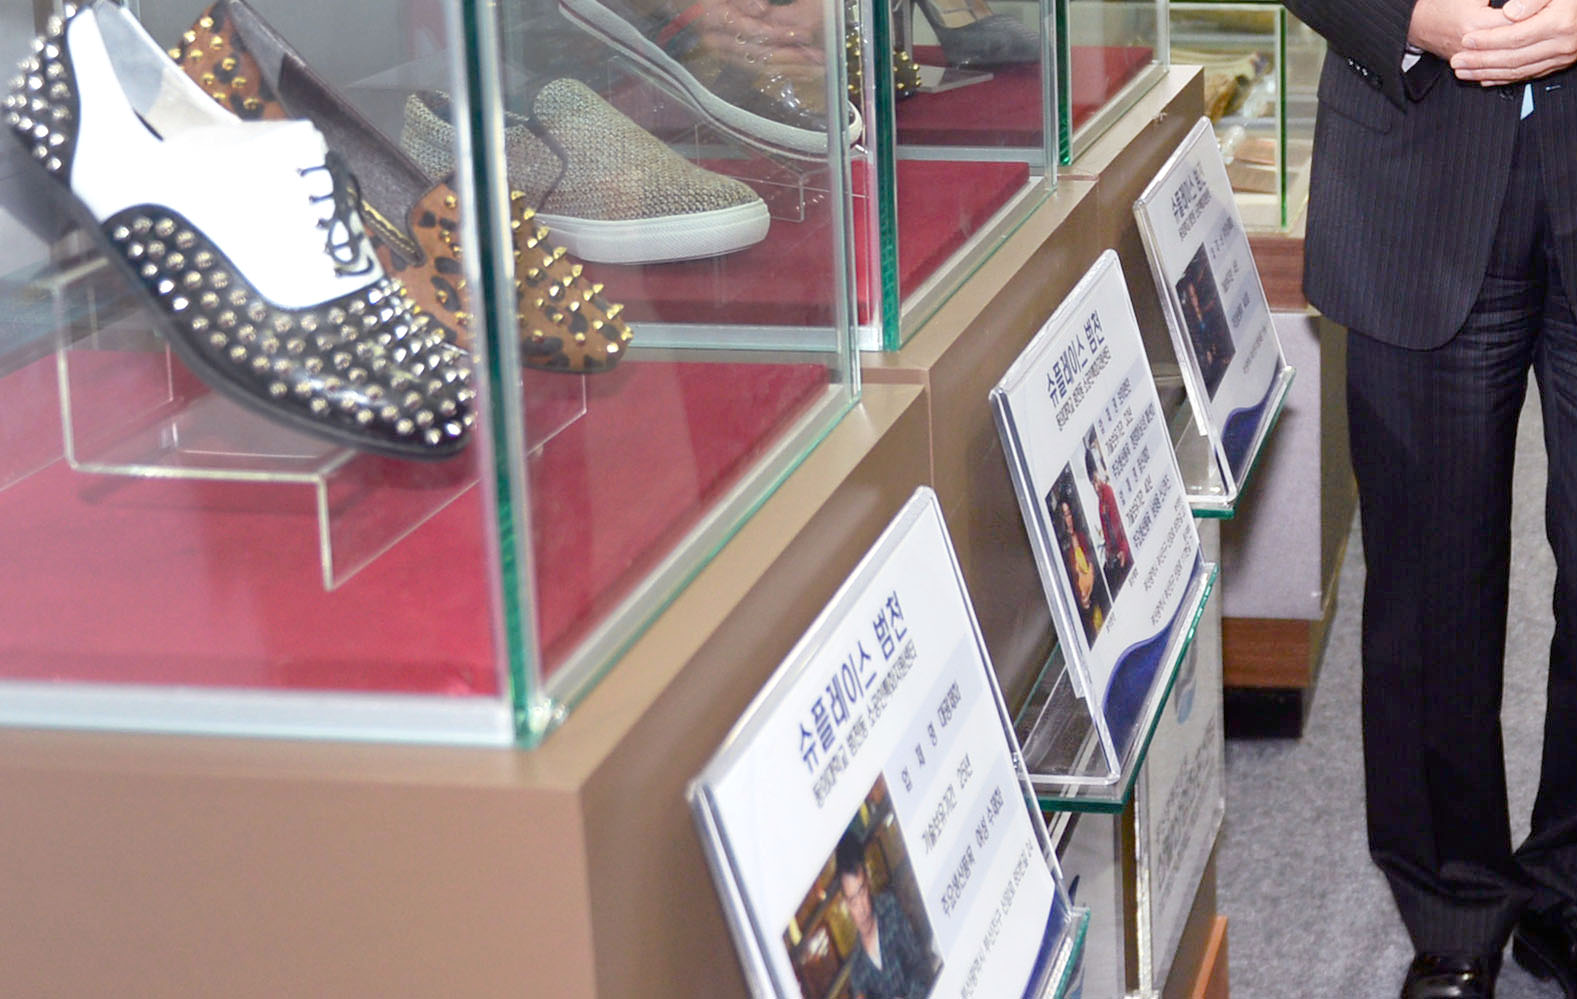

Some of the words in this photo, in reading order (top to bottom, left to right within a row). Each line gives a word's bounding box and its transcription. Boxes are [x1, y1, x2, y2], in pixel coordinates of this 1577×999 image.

[1047, 334, 1088, 408] 슈플레이스
[1083, 310, 1105, 354] 범천
[799, 639, 877, 774] 슈플레이스
[872, 589, 908, 661] 범천
